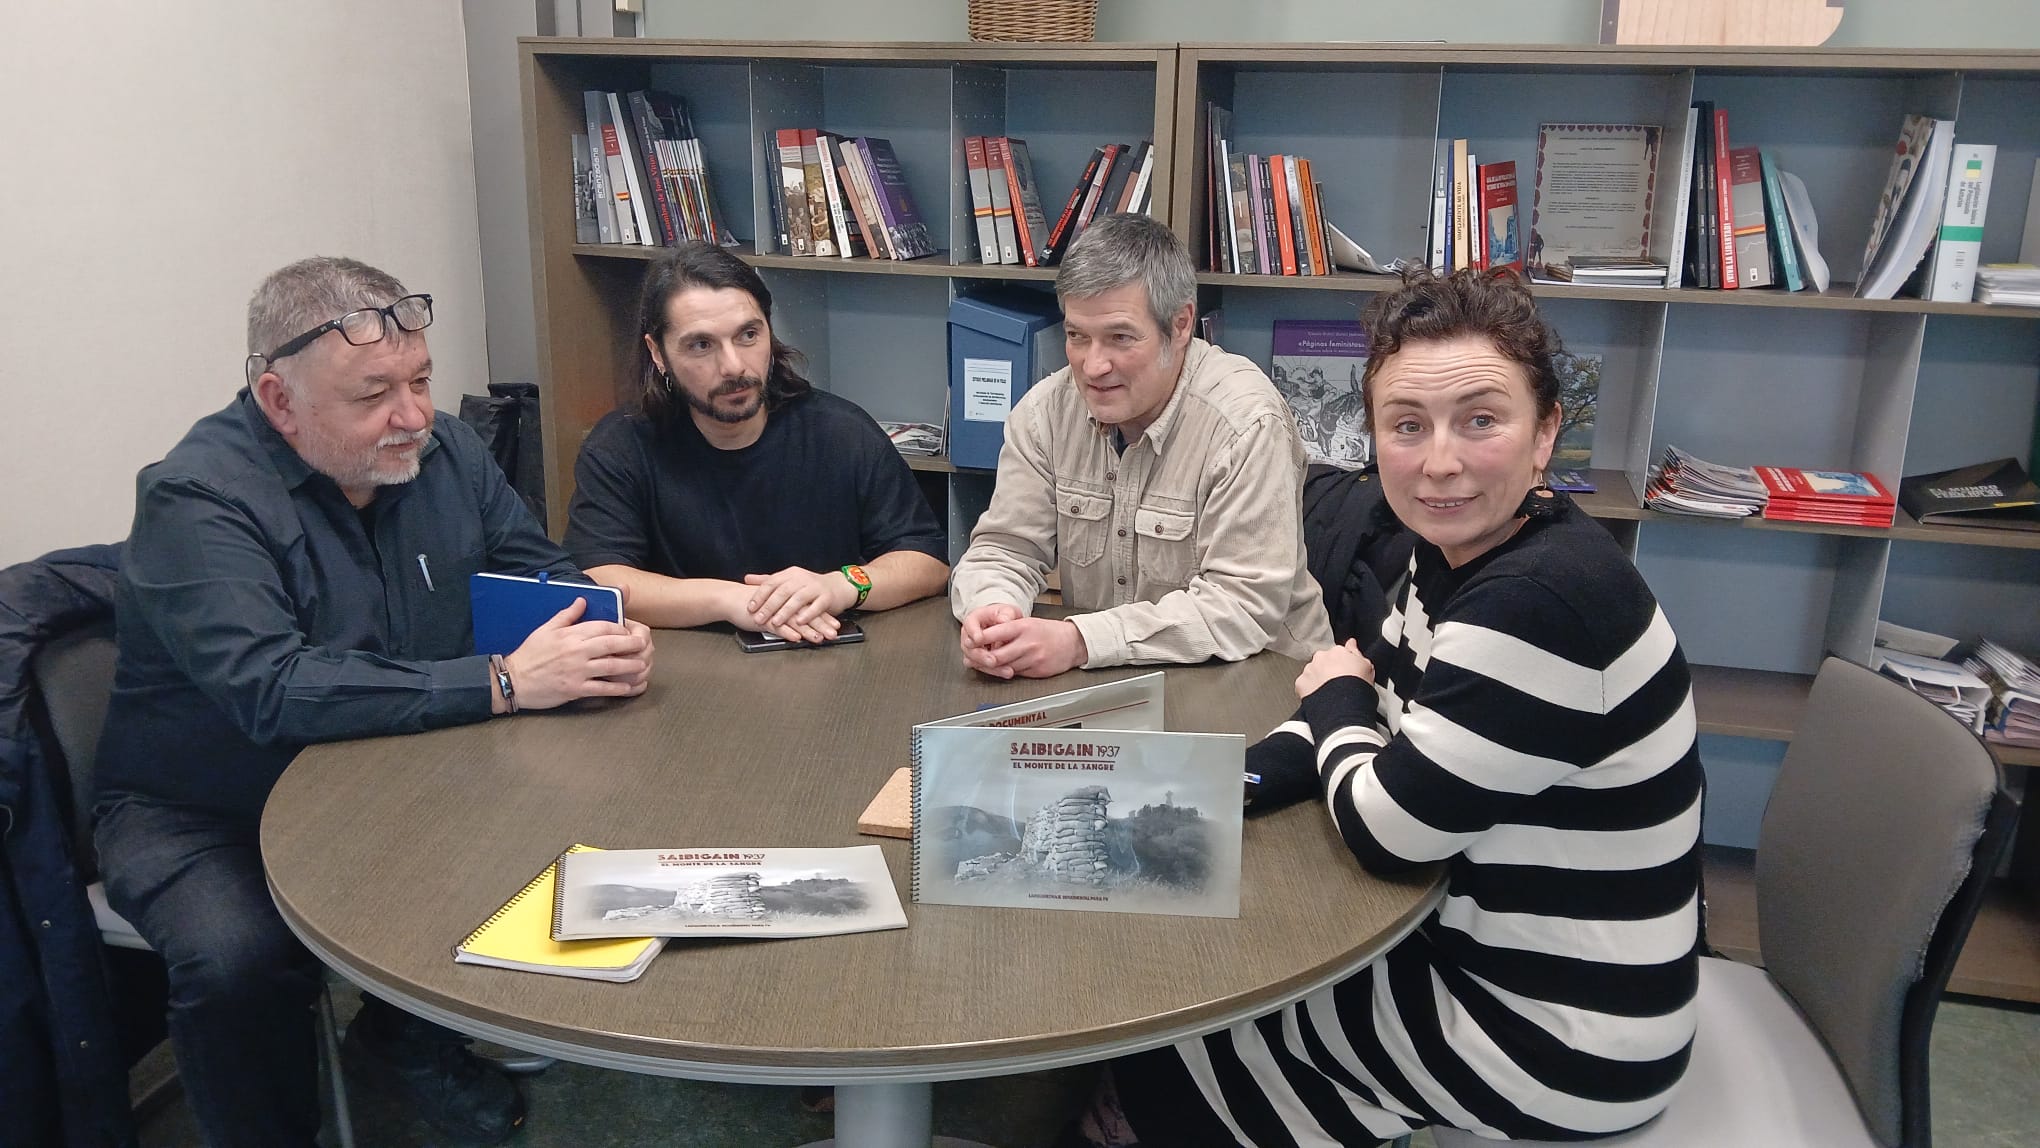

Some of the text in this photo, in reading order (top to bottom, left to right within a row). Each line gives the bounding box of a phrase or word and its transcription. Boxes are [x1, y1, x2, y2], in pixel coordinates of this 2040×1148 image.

[657, 193, 665, 202] de
[1725, 255, 1734, 264] LA
[989, 711, 1047, 727] DOCUMENTAL
[1010, 742, 1120, 758] SAIBIGAIN 1937
[1024, 762, 1053, 770] MONTE
[1081, 763, 1114, 771] SANGRE
